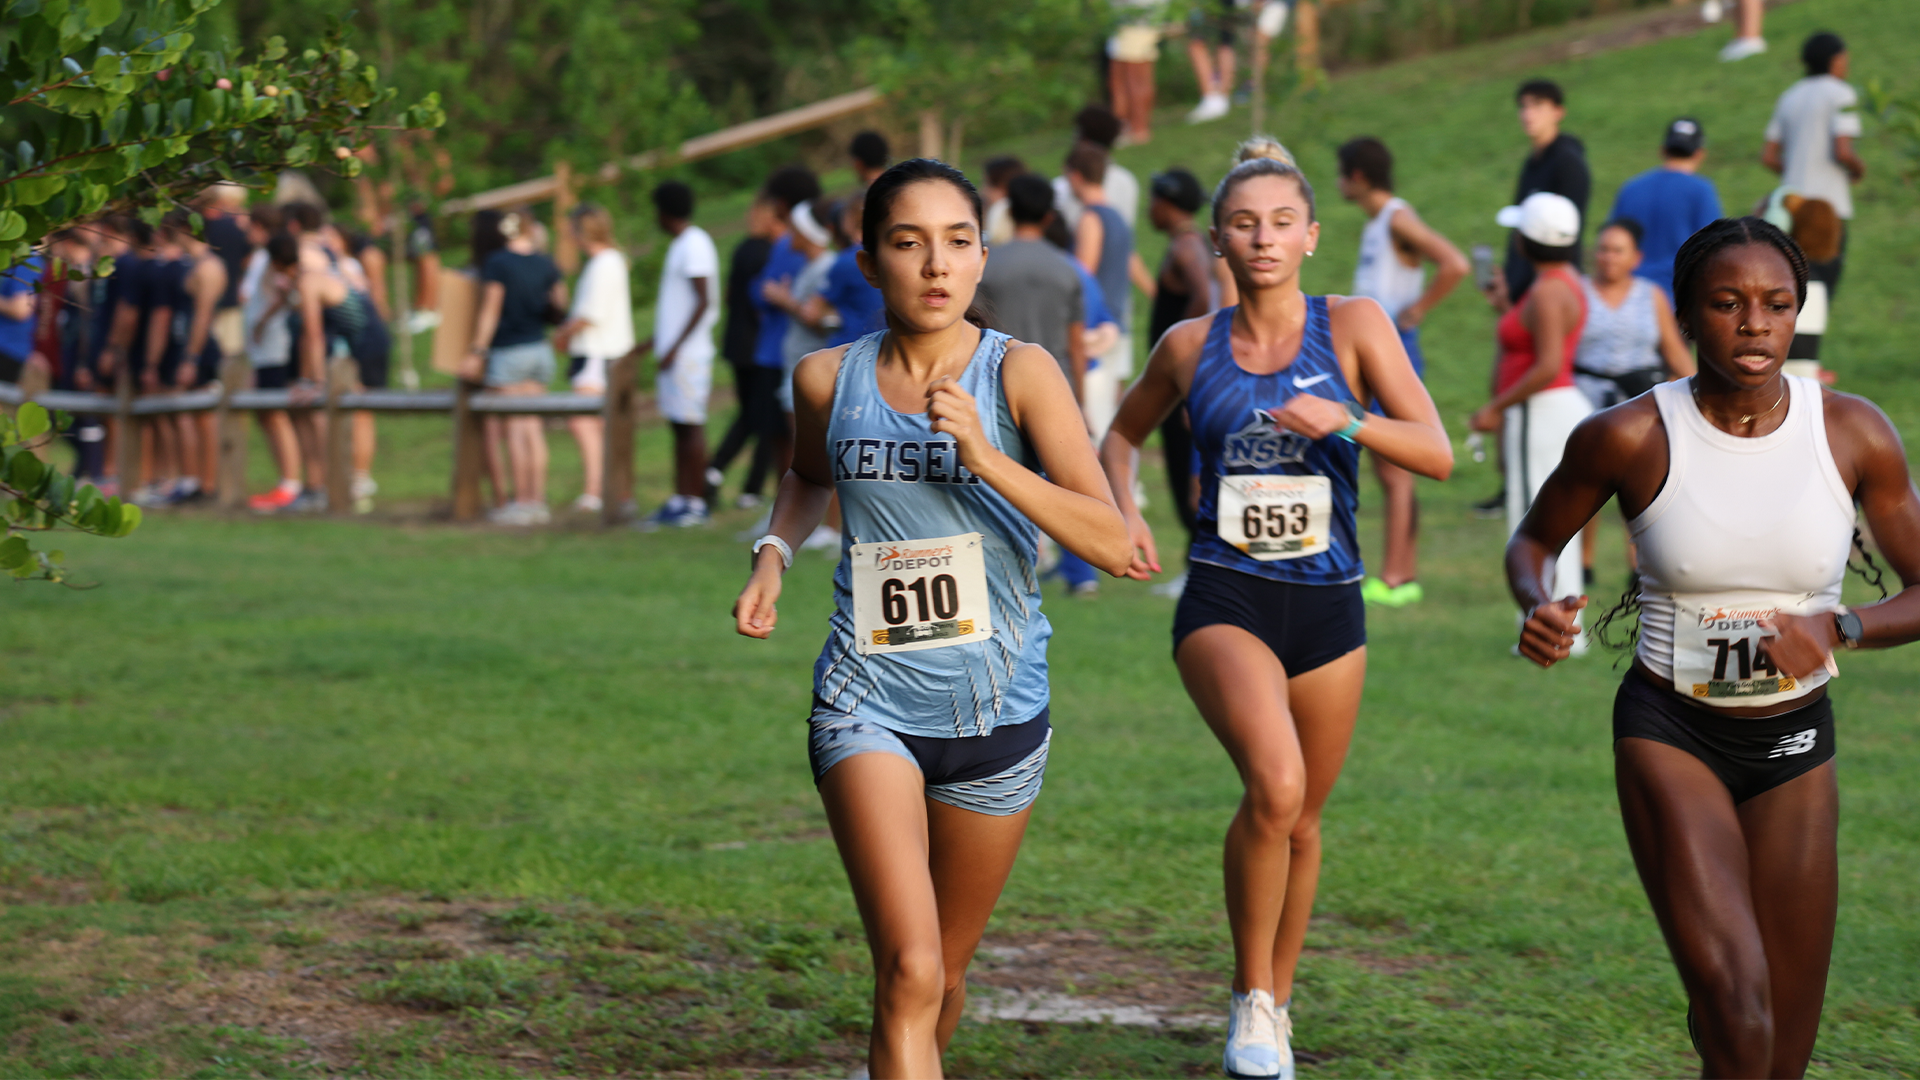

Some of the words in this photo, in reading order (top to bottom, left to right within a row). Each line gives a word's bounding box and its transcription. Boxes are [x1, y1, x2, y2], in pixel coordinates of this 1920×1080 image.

[1226, 434, 1312, 466] NSU
[1243, 503, 1310, 539] 653
[893, 555, 953, 571] DEPOT
[901, 545, 954, 559] Runner's
[881, 573, 959, 626] 610
[1717, 620, 1756, 631] DEP
[1706, 634, 1779, 681] 714
